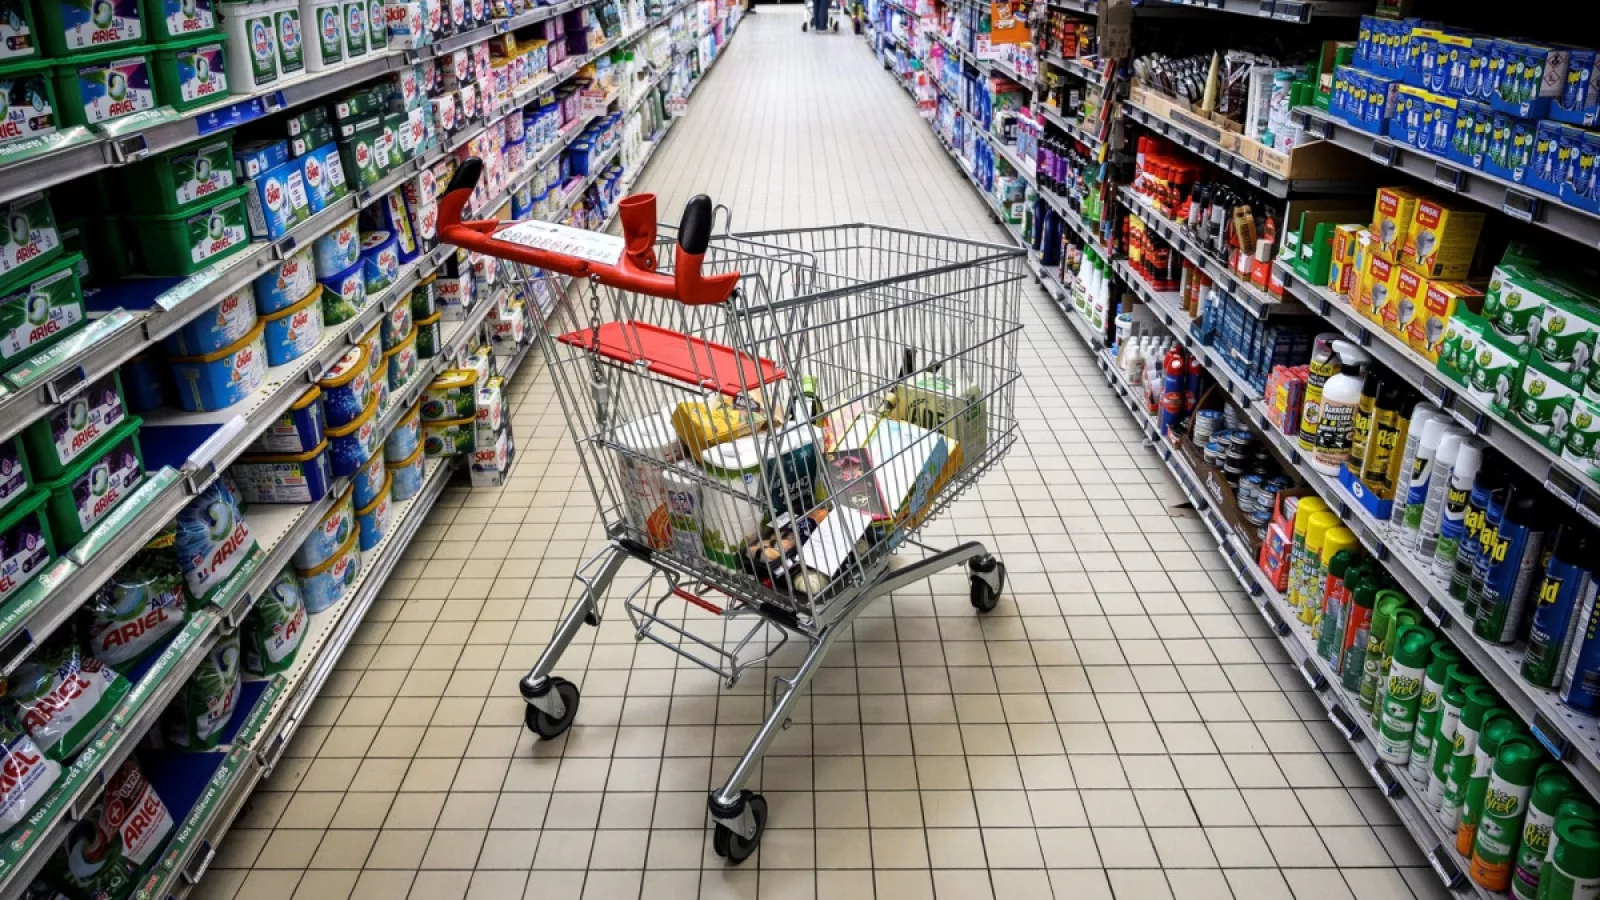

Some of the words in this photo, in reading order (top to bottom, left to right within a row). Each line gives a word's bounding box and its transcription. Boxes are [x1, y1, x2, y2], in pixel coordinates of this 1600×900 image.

[92, 28, 121, 45] ARIEL
[197, 83, 216, 96] ARIEL
[109, 101, 137, 116] ARIEL
[0, 122, 22, 138] IEL
[196, 181, 218, 196] ARIEL
[16, 243, 41, 263] ARIEL
[210, 237, 232, 254] ARIEL
[29, 320, 60, 344] ARIEL
[72, 426, 100, 451] ARIEL
[93, 488, 119, 517] ARIEL
[211, 523, 248, 573] ARIEL
[103, 607, 169, 650] ARIEL
[23, 673, 91, 736] ARIEL
[29, 808, 47, 825] Nos
[123, 798, 161, 849] ARIEL
[177, 826, 192, 843] Nos
[189, 787, 216, 827] meilleures
